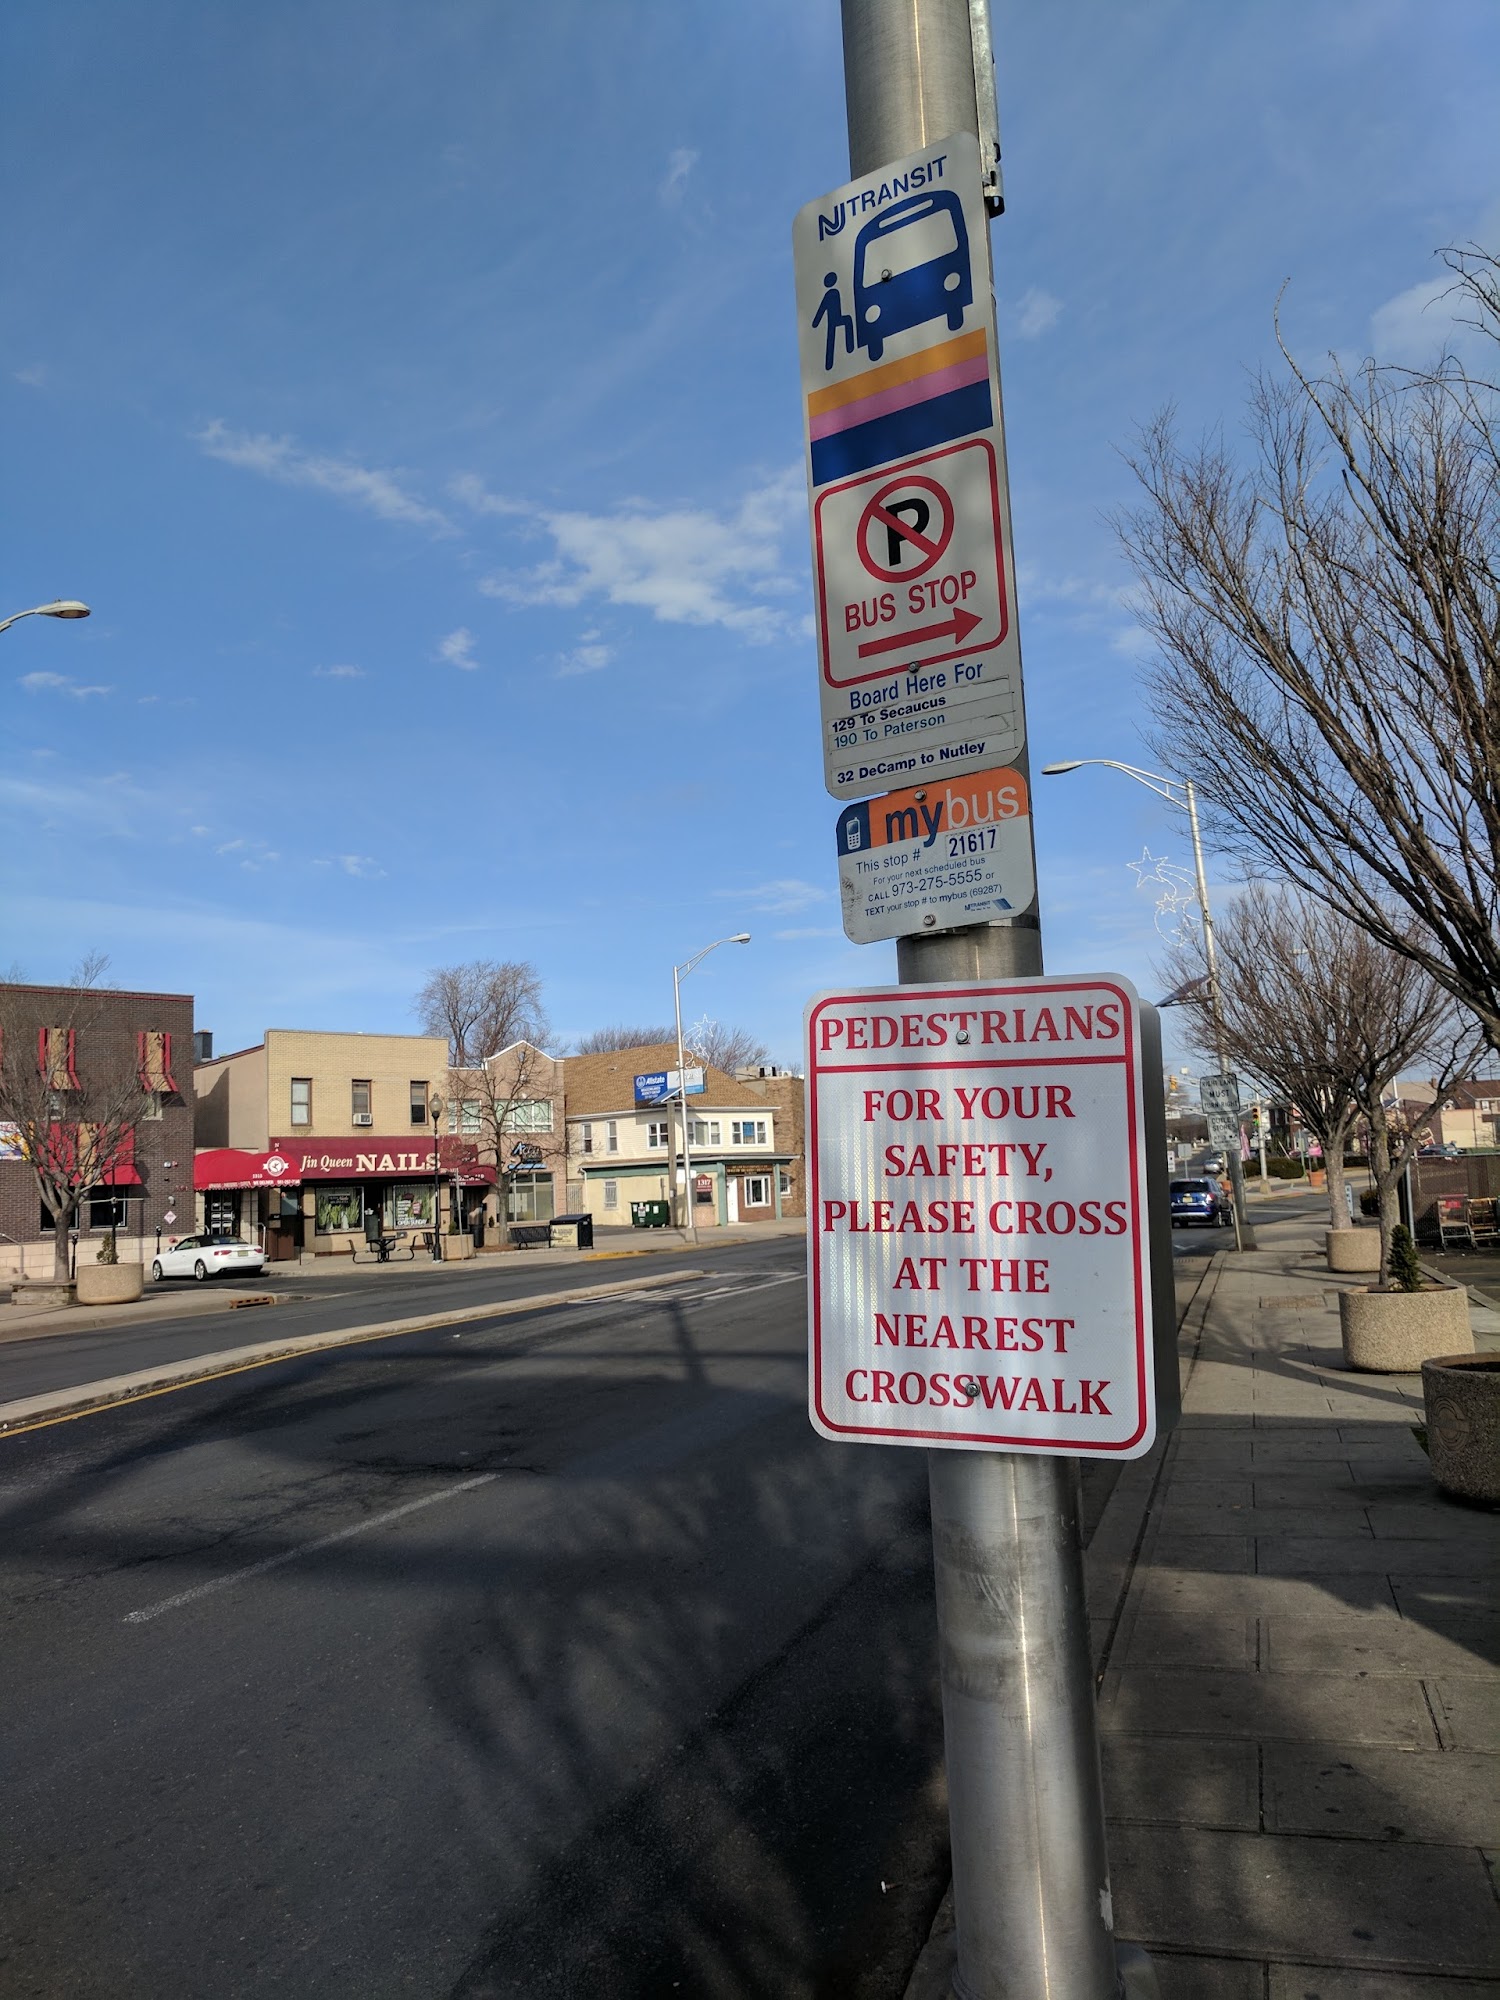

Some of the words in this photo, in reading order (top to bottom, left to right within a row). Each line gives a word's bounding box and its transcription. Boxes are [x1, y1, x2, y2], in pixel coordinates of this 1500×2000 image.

[844, 593, 897, 633] BUS
[908, 570, 977, 614] STOP
[850, 681, 899, 710] Board
[906, 672, 947, 696] Here
[955, 662, 984, 684] For
[832, 718, 856, 733] 129
[861, 712, 876, 725] To
[880, 695, 947, 720] Secaucus
[834, 732, 858, 748] 190
[863, 728, 878, 741] To
[884, 713, 946, 737] Paterson
[837, 770, 855, 784] 32
[859, 757, 917, 781] DeCamp
[920, 752, 935, 765] to
[939, 740, 986, 760] Nutley
[856, 860, 880, 875] This
[883, 854, 909, 869] stop
[913, 848, 921, 862] #
[948, 829, 997, 857] 21617
[873, 874, 885, 885] For
[886, 873, 903, 885] your
[905, 869, 922, 878] next
[924, 859, 968, 875] scheduled
[969, 855, 986, 866] bus
[865, 905, 885, 917] TEXT
[886, 901, 903, 915] your
[903, 898, 920, 910] stop
[921, 895, 928, 907] #
[929, 894, 938, 904] to
[939, 890, 968, 905] mybus
[970, 883, 1003, 900] (69287)
[868, 891, 890, 903] CALL
[892, 869, 983, 898] 973-275-5555
[985, 871, 995, 880] or
[820, 1004, 1120, 1052] PEDESTRIANS
[646, 1076, 666, 1086] Allstate
[1209, 1090, 1230, 1098] MUST
[863, 1089, 945, 1122] FOR
[954, 1085, 1076, 1119] YOUR
[1220, 1100, 1238, 1108] RIGHT
[1212, 1124, 1236, 1132] STORES
[300, 1155, 318, 1173] Jin
[320, 1154, 353, 1173] Queen
[356, 1153, 441, 1172] NAILS
[885, 1143, 1054, 1182] SAFETY,
[823, 1200, 976, 1233] PLEASE
[988, 1200, 1127, 1235] CROSS
[893, 1257, 947, 1290] AT
[960, 1258, 1050, 1293] THE
[874, 1313, 1075, 1354] NEAREST
[845, 1369, 1113, 1416] CROSSWALK
